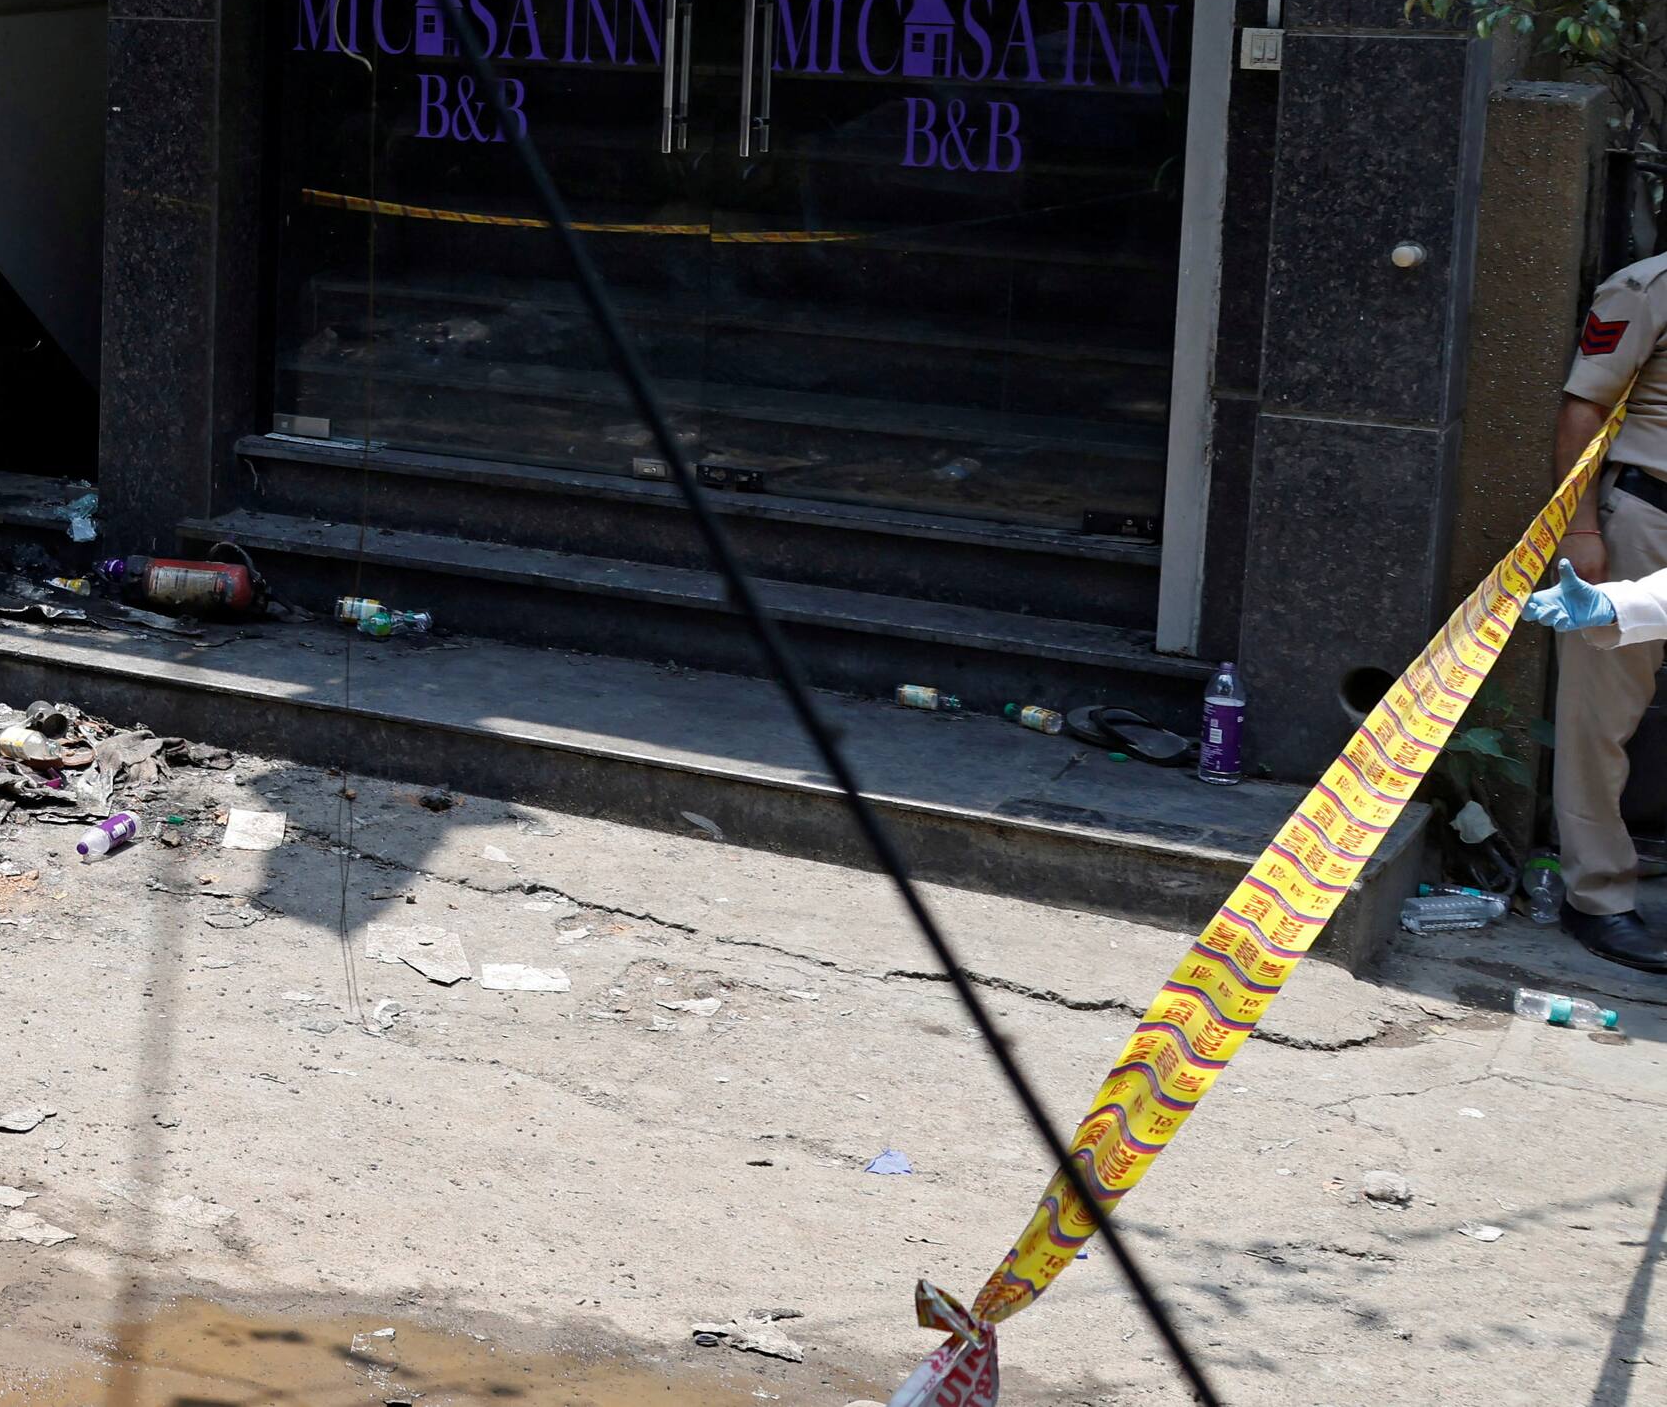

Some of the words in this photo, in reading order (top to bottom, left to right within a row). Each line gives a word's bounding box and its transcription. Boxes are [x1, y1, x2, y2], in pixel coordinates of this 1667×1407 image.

[1062, 1, 1180, 92] INN
[413, 72, 532, 145] B&B
[899, 96, 1025, 174] B&B
[1445, 665, 1469, 689] POLICE
[1374, 718, 1396, 747] DELHI
[1393, 741, 1422, 766] POLICE
[1311, 800, 1338, 831] DELHI
[1336, 824, 1369, 852] POLICE
[1303, 843, 1327, 872] CROSS
[1326, 862, 1351, 879] LINE
[1240, 894, 1272, 922] DELHI
[1205, 935, 1230, 957] DO
[1213, 921, 1237, 942] NOT
[1269, 912, 1304, 952] POLICE
[1229, 937, 1259, 969] CROSS
[1256, 960, 1285, 979] LINE
[1161, 999, 1196, 1032] DELHI
[1190, 1019, 1229, 1058] POLICE
[1146, 1042, 1185, 1081] CROSS
[1171, 1071, 1204, 1093] LINE
[1097, 1138, 1138, 1187] POLICE
